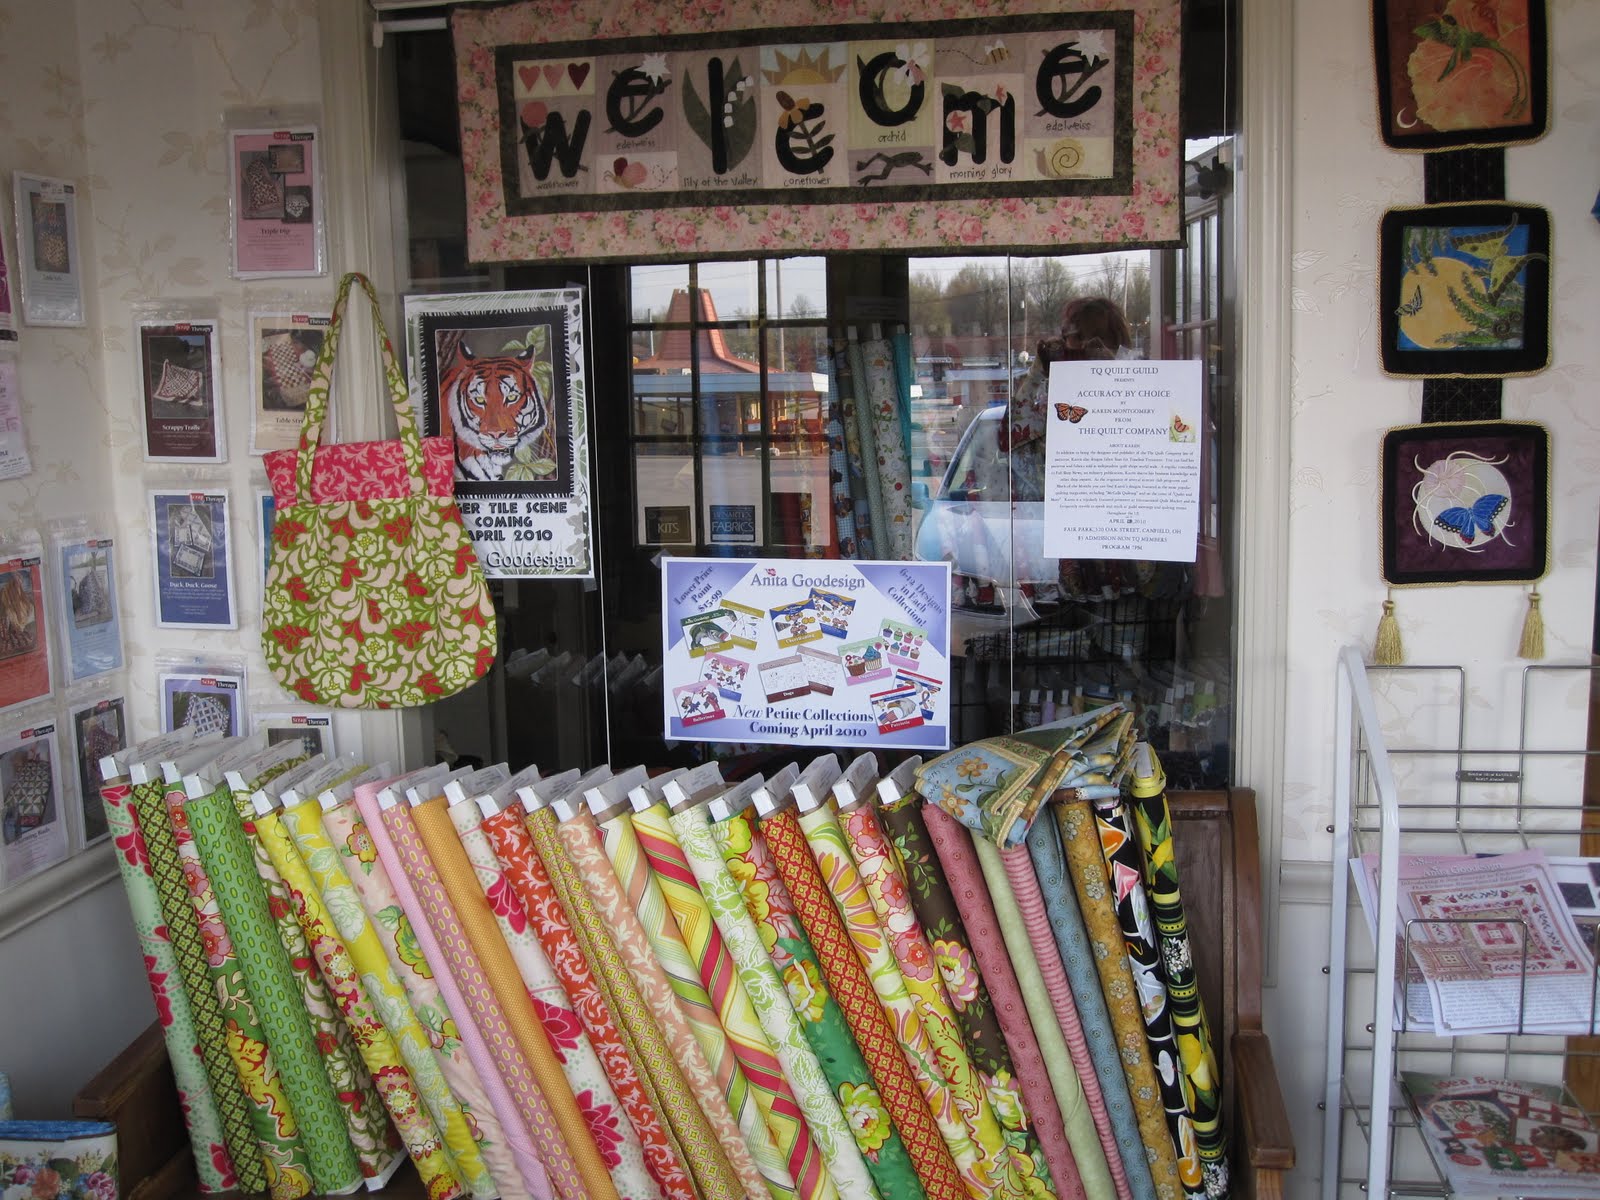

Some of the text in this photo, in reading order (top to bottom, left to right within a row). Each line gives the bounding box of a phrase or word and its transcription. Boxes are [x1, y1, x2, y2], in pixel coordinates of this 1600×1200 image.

[1045, 120, 1091, 132] edelweiss
[877, 130, 907, 144] orchid
[949, 165, 1013, 180] morning glory
[783, 175, 831, 187] coneflower
[1091, 368, 1103, 376] TQ
[1133, 367, 1159, 375] GUILD
[1077, 390, 1123, 398] ACCURACY
[1138, 390, 1171, 398] CHOICE
[1078, 427, 1169, 436] THE QUILT COMPANY
[489, 502, 518, 514] TILE
[526, 502, 568, 513] SCENE
[475, 516, 532, 527] COMING
[658, 522, 680, 534] KITS
[711, 521, 754, 532] FABRICS
[469, 529, 553, 541] APRIL 2010
[486, 551, 576, 571] Goodesign
[673, 566, 713, 606] Lower Price
[750, 573, 865, 591] Anita Goodesign
[690, 583, 712, 603] Point
[900, 584, 927, 613] in Each
[915, 583, 943, 615] Designs
[887, 586, 928, 627] Collection!
[733, 704, 874, 721] New Petite Collections
[750, 721, 868, 739] Coming April 2010
